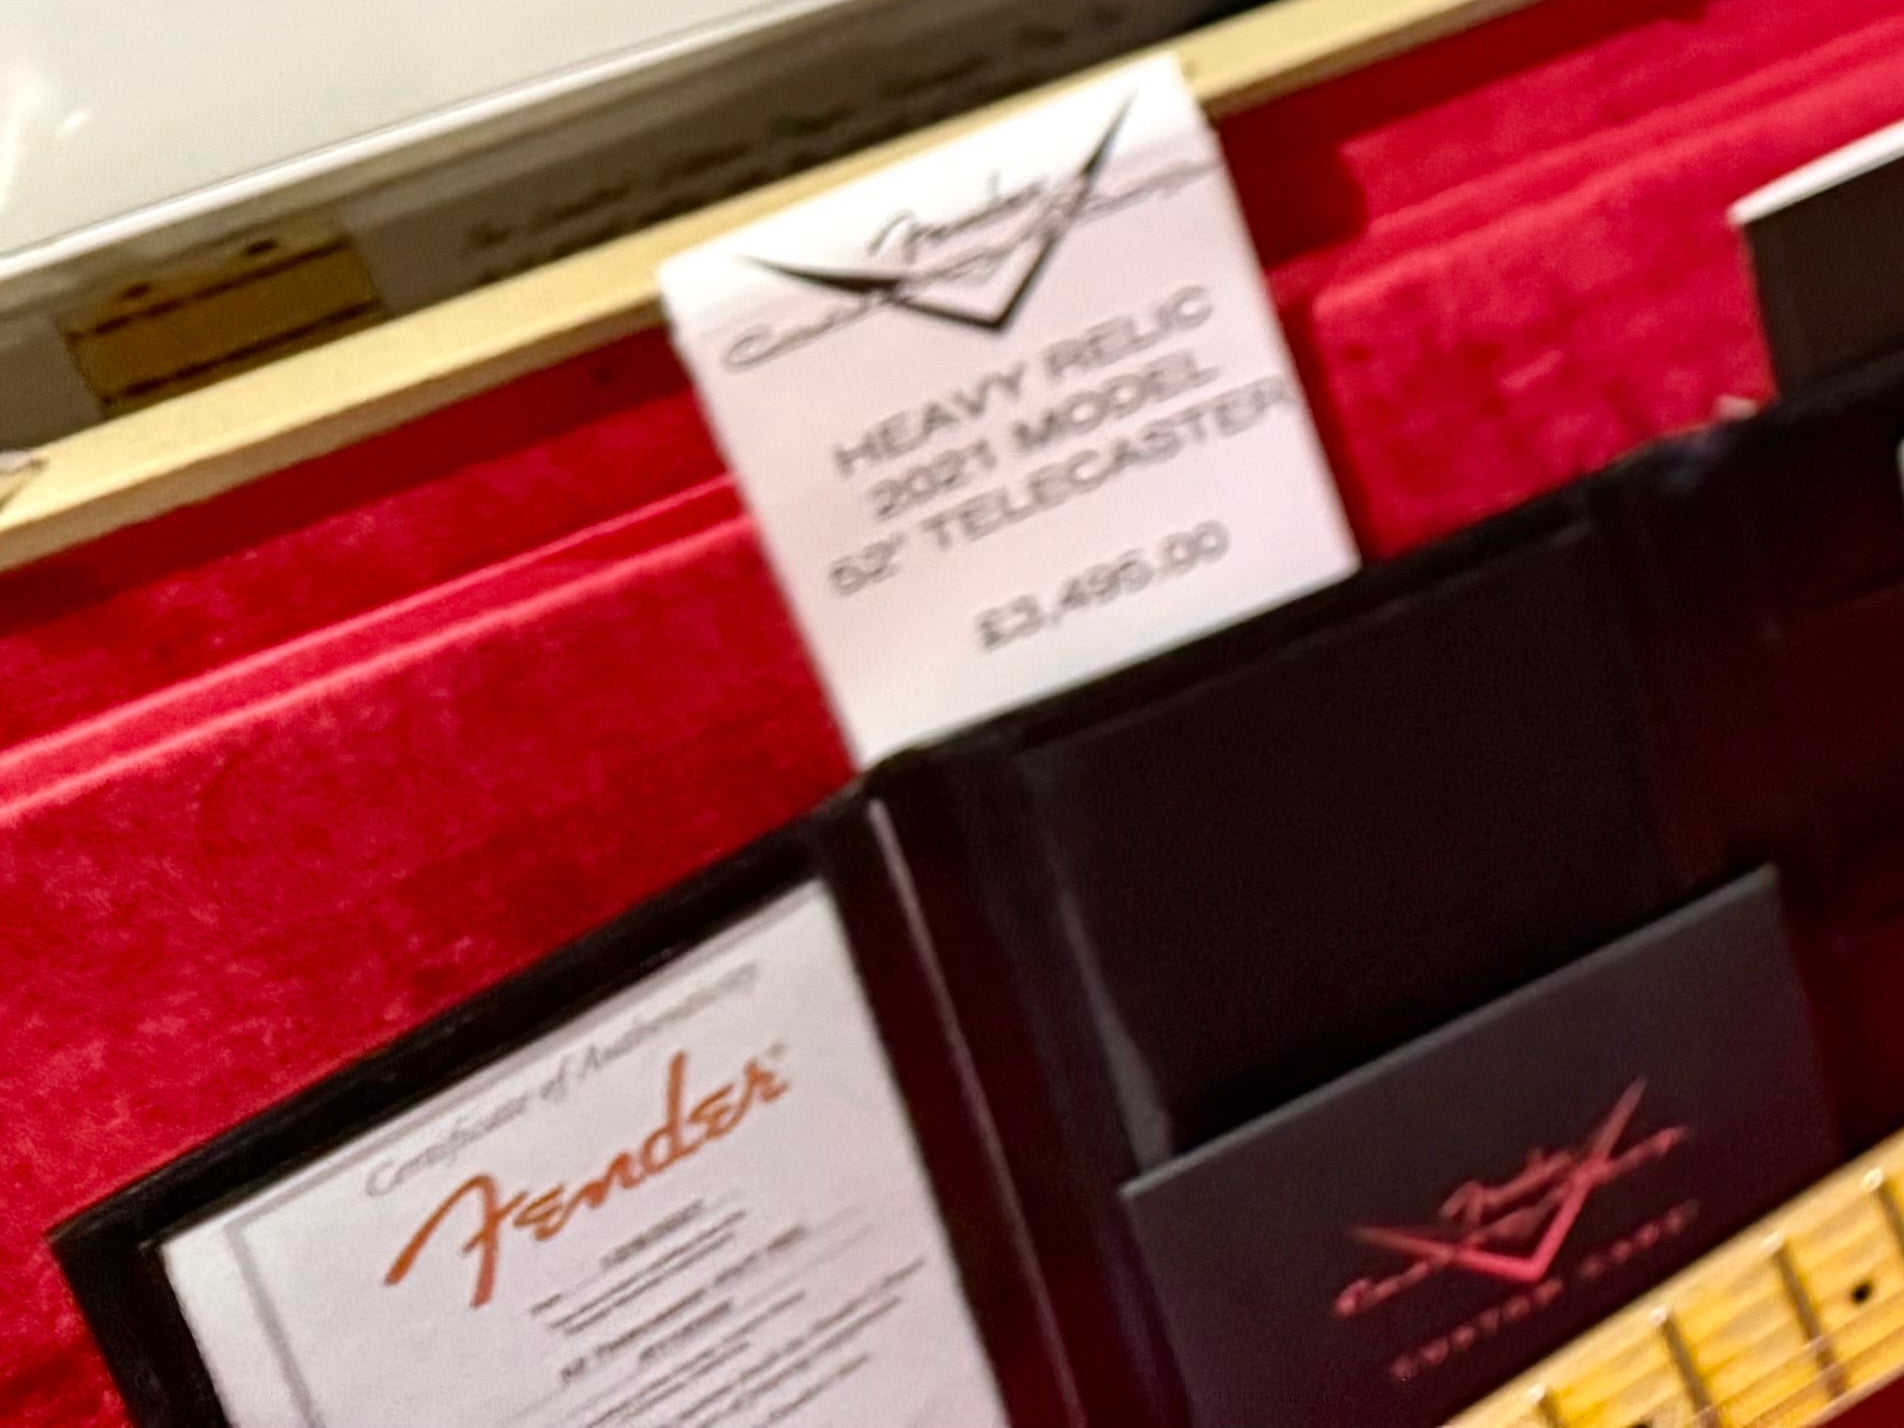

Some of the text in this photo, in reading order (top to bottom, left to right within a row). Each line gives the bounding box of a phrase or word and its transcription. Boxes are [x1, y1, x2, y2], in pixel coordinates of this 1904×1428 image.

[833, 284, 1215, 478] HEAVY RELIC
[867, 349, 1221, 522] 2021 MODEL
[919, 374, 1303, 551] TELECASTER
[973, 518, 1231, 652] £3,495.00
[383, 1049, 791, 1312] Fender
